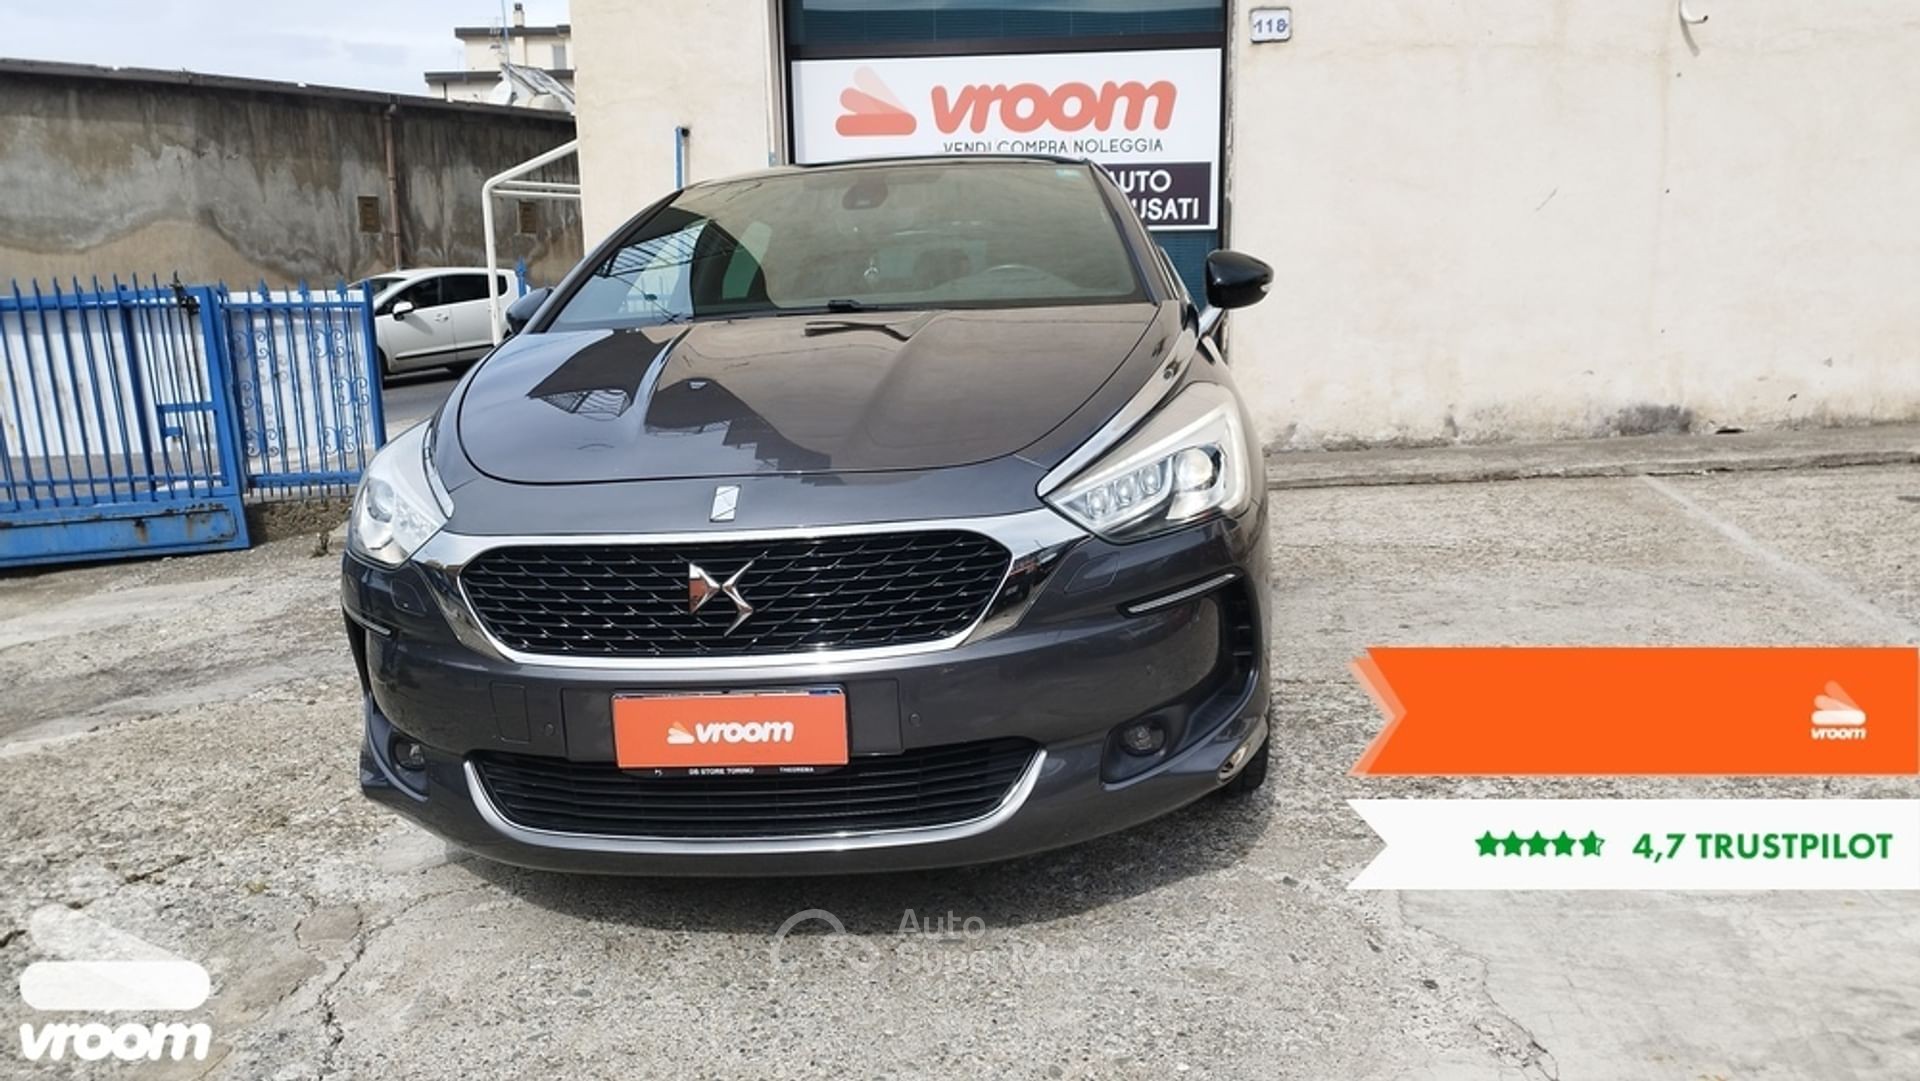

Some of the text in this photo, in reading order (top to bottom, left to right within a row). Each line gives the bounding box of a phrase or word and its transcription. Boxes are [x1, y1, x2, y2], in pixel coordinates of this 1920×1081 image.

[1254, 18, 1288, 33] 118
[931, 81, 1177, 134] vroom
[1073, 138, 1163, 153] NOLEGGIA
[695, 721, 794, 744] vroom
